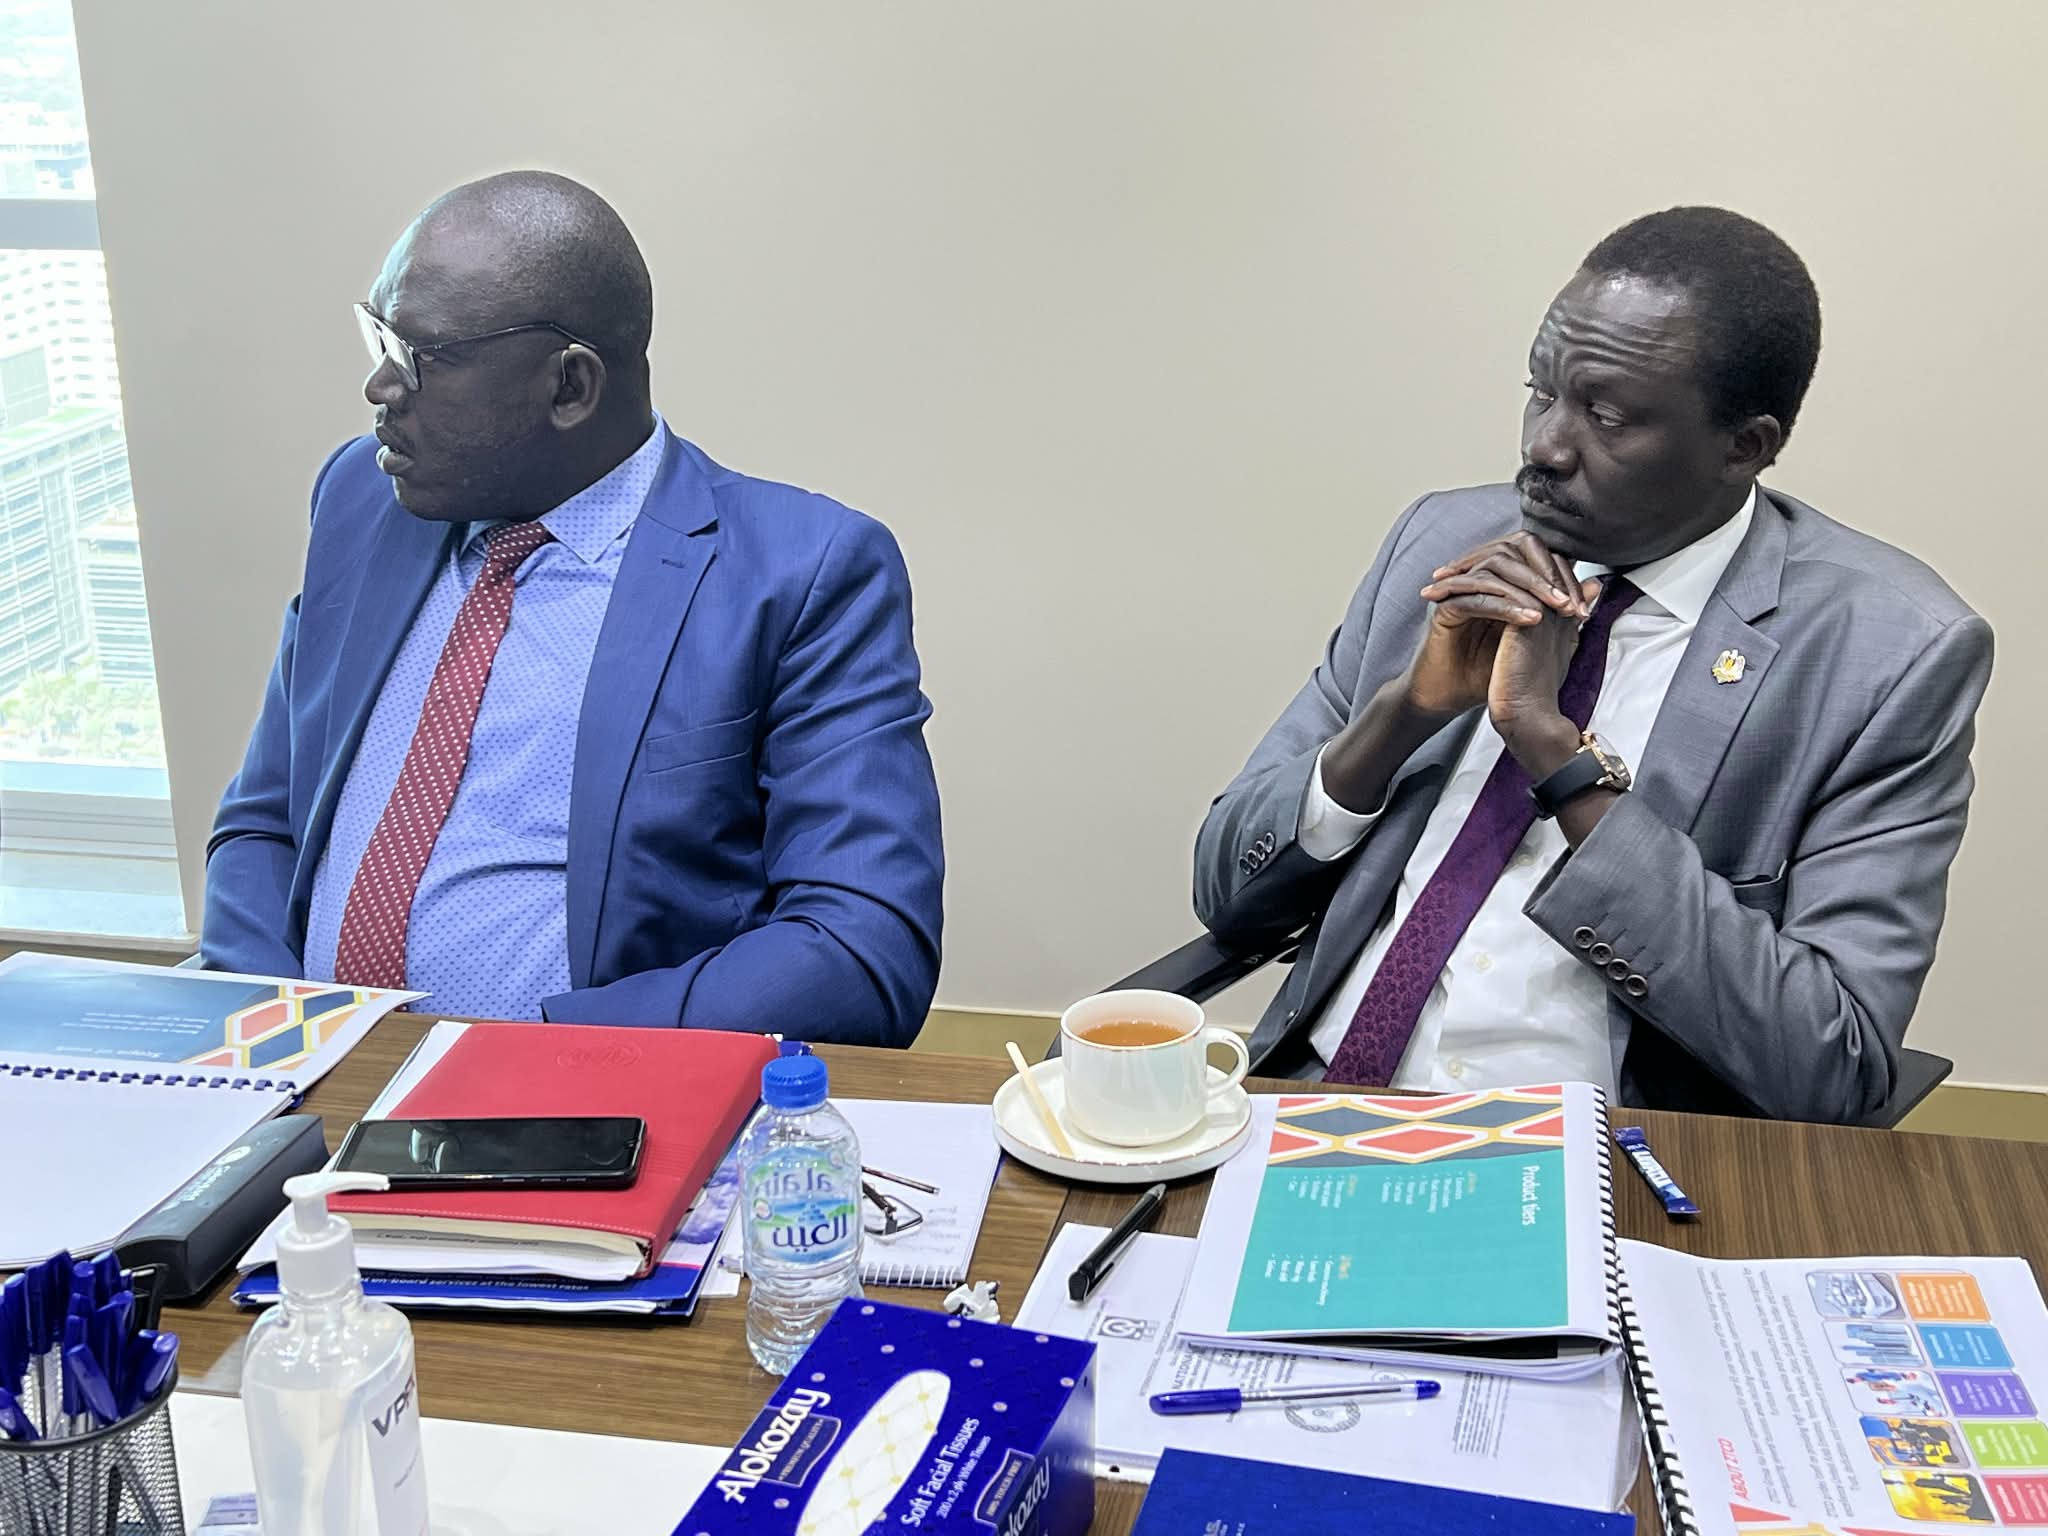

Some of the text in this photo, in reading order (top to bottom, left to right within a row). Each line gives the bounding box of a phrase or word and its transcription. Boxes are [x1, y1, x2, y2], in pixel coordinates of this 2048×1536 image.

[1521, 1164, 1541, 1202] Product
[772, 1213, 848, 1253] العين
[716, 1388, 831, 1504] Alokozay
[901, 1417, 980, 1528] Soft Facial Tissues
